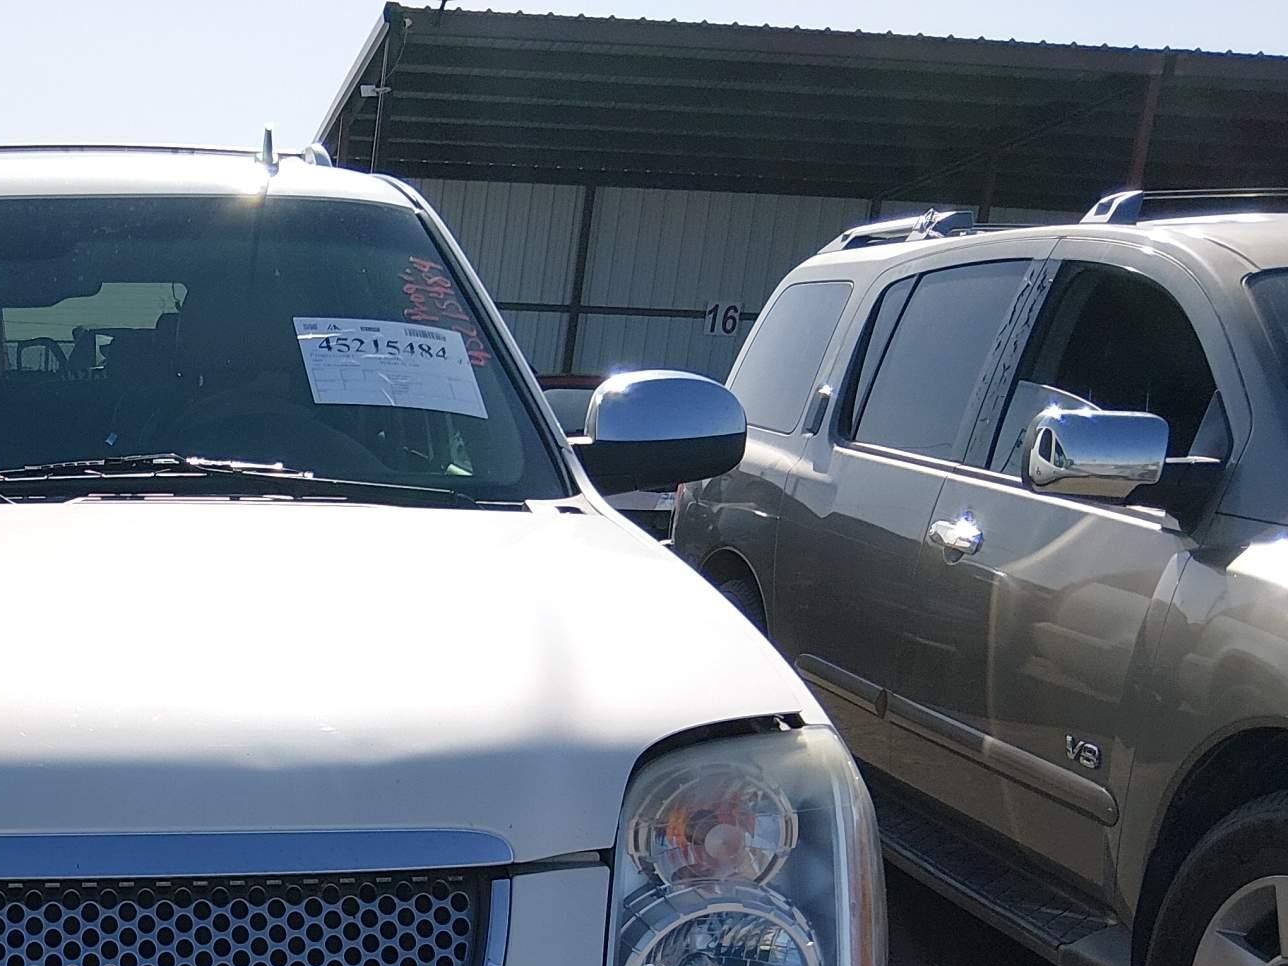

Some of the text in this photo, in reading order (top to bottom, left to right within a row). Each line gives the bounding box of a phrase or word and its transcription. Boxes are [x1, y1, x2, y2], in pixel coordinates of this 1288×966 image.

[708, 303, 739, 334] 16
[318, 336, 449, 361] 45215484
[1065, 734, 1100, 769] V8
